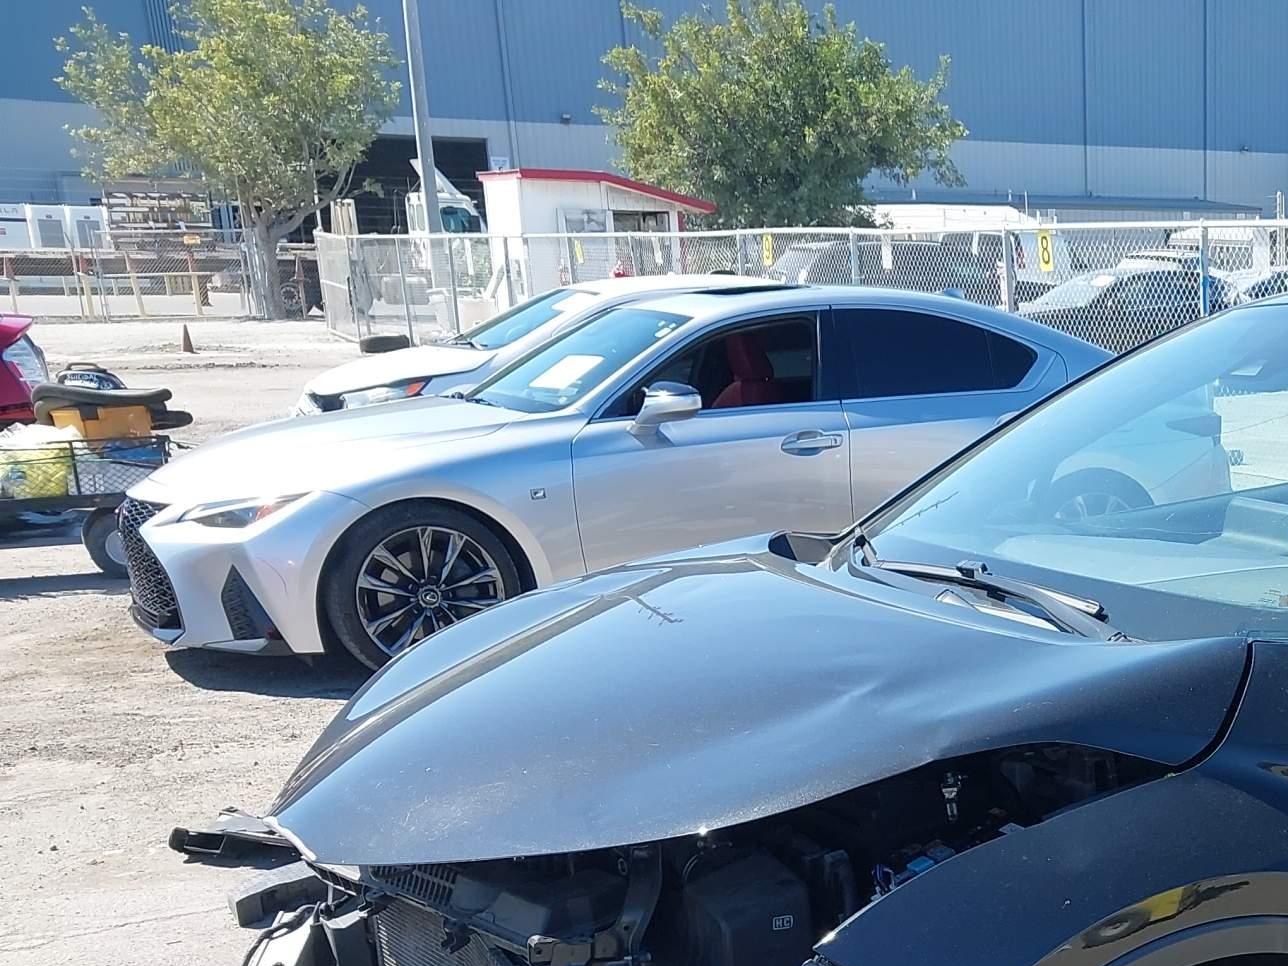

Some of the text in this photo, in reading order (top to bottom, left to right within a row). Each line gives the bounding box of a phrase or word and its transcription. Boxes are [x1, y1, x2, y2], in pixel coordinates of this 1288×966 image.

[764, 236, 771, 260] 9
[1041, 235, 1050, 264] 8
[775, 917, 790, 928] HC
